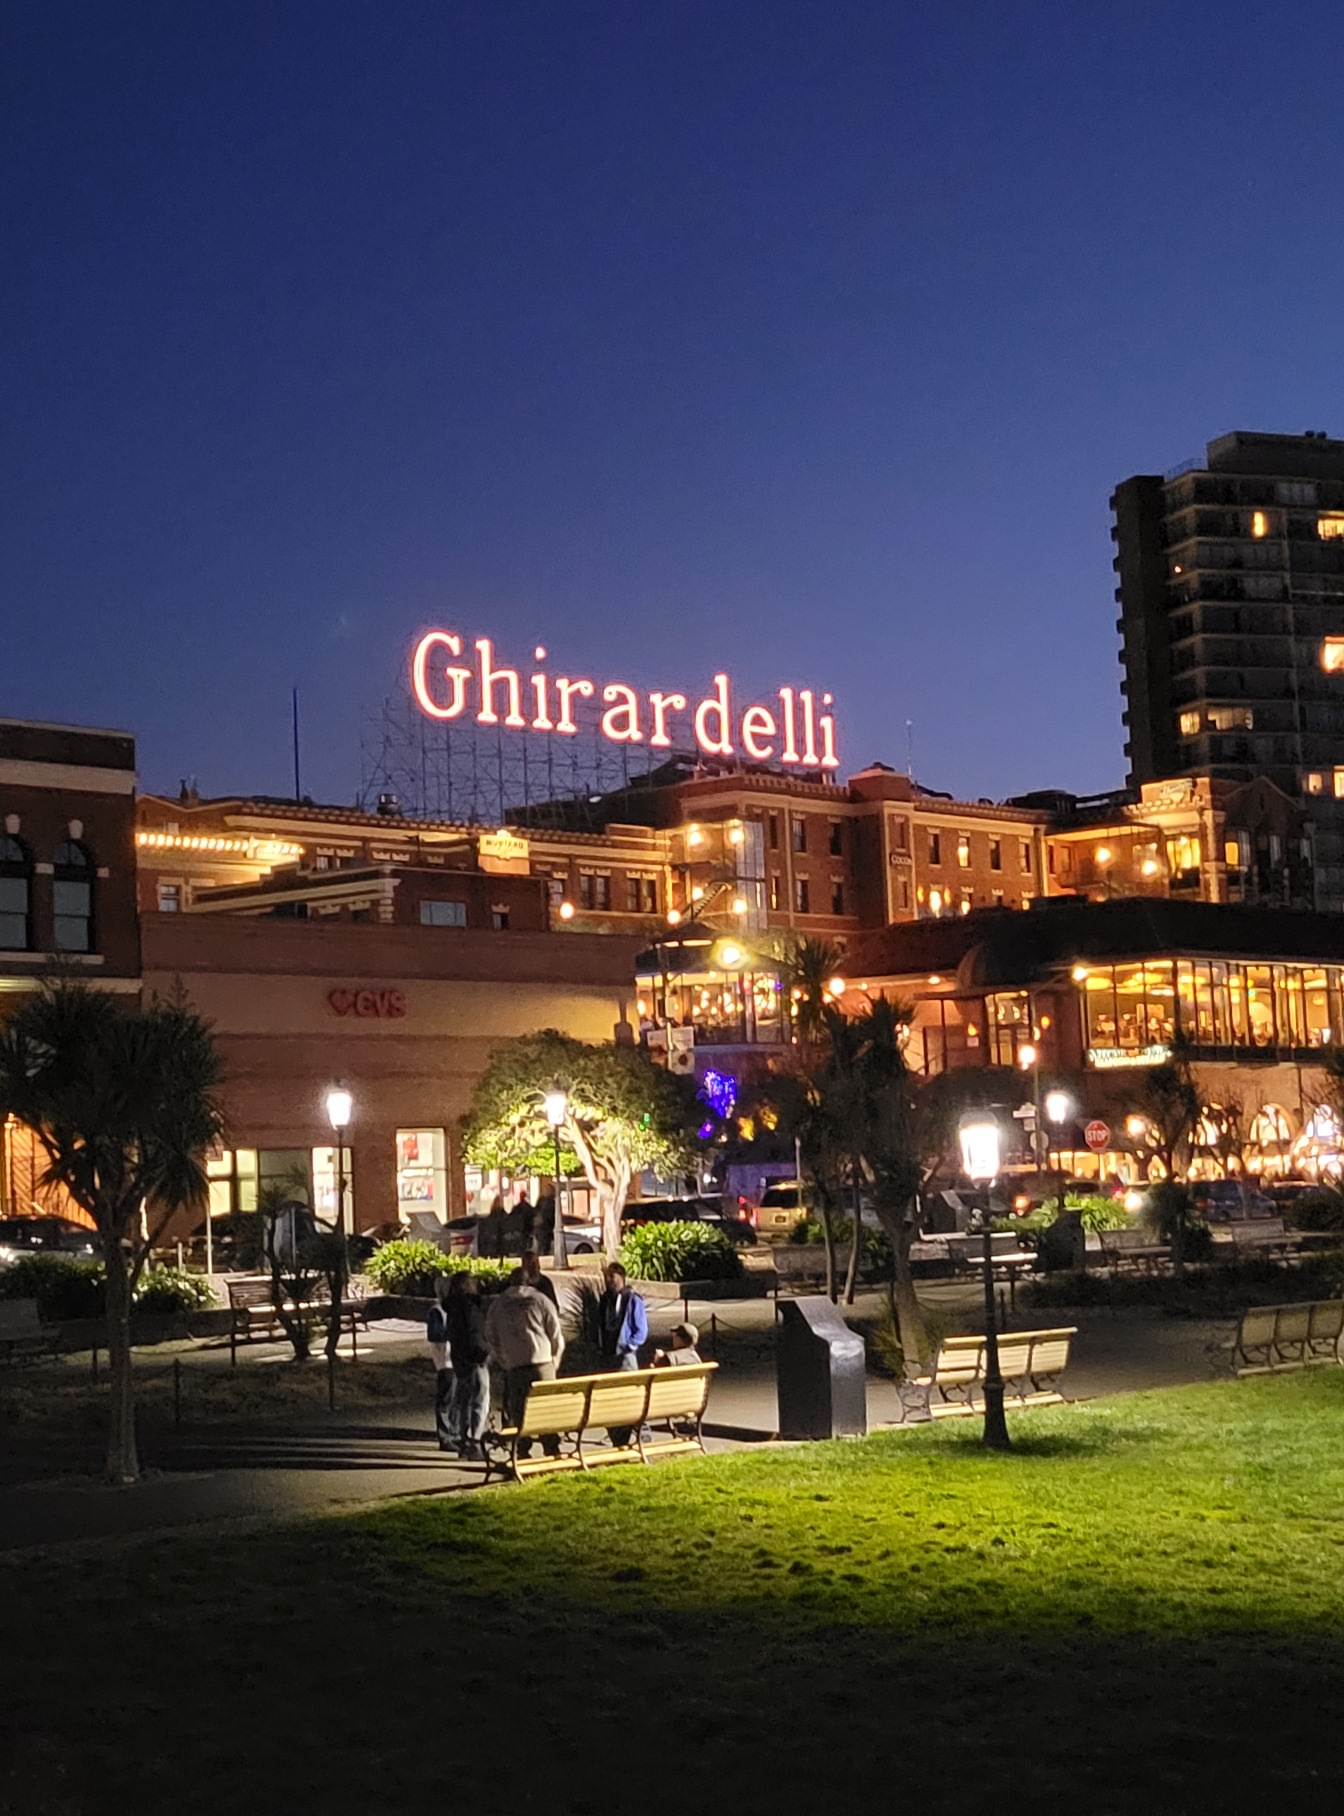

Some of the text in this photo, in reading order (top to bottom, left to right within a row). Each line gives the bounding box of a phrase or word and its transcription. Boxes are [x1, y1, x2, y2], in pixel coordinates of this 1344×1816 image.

[410, 629, 840, 768] Ghirardelli
[356, 990, 406, 1018] CVS
[1087, 1129, 1108, 1141] STOP
